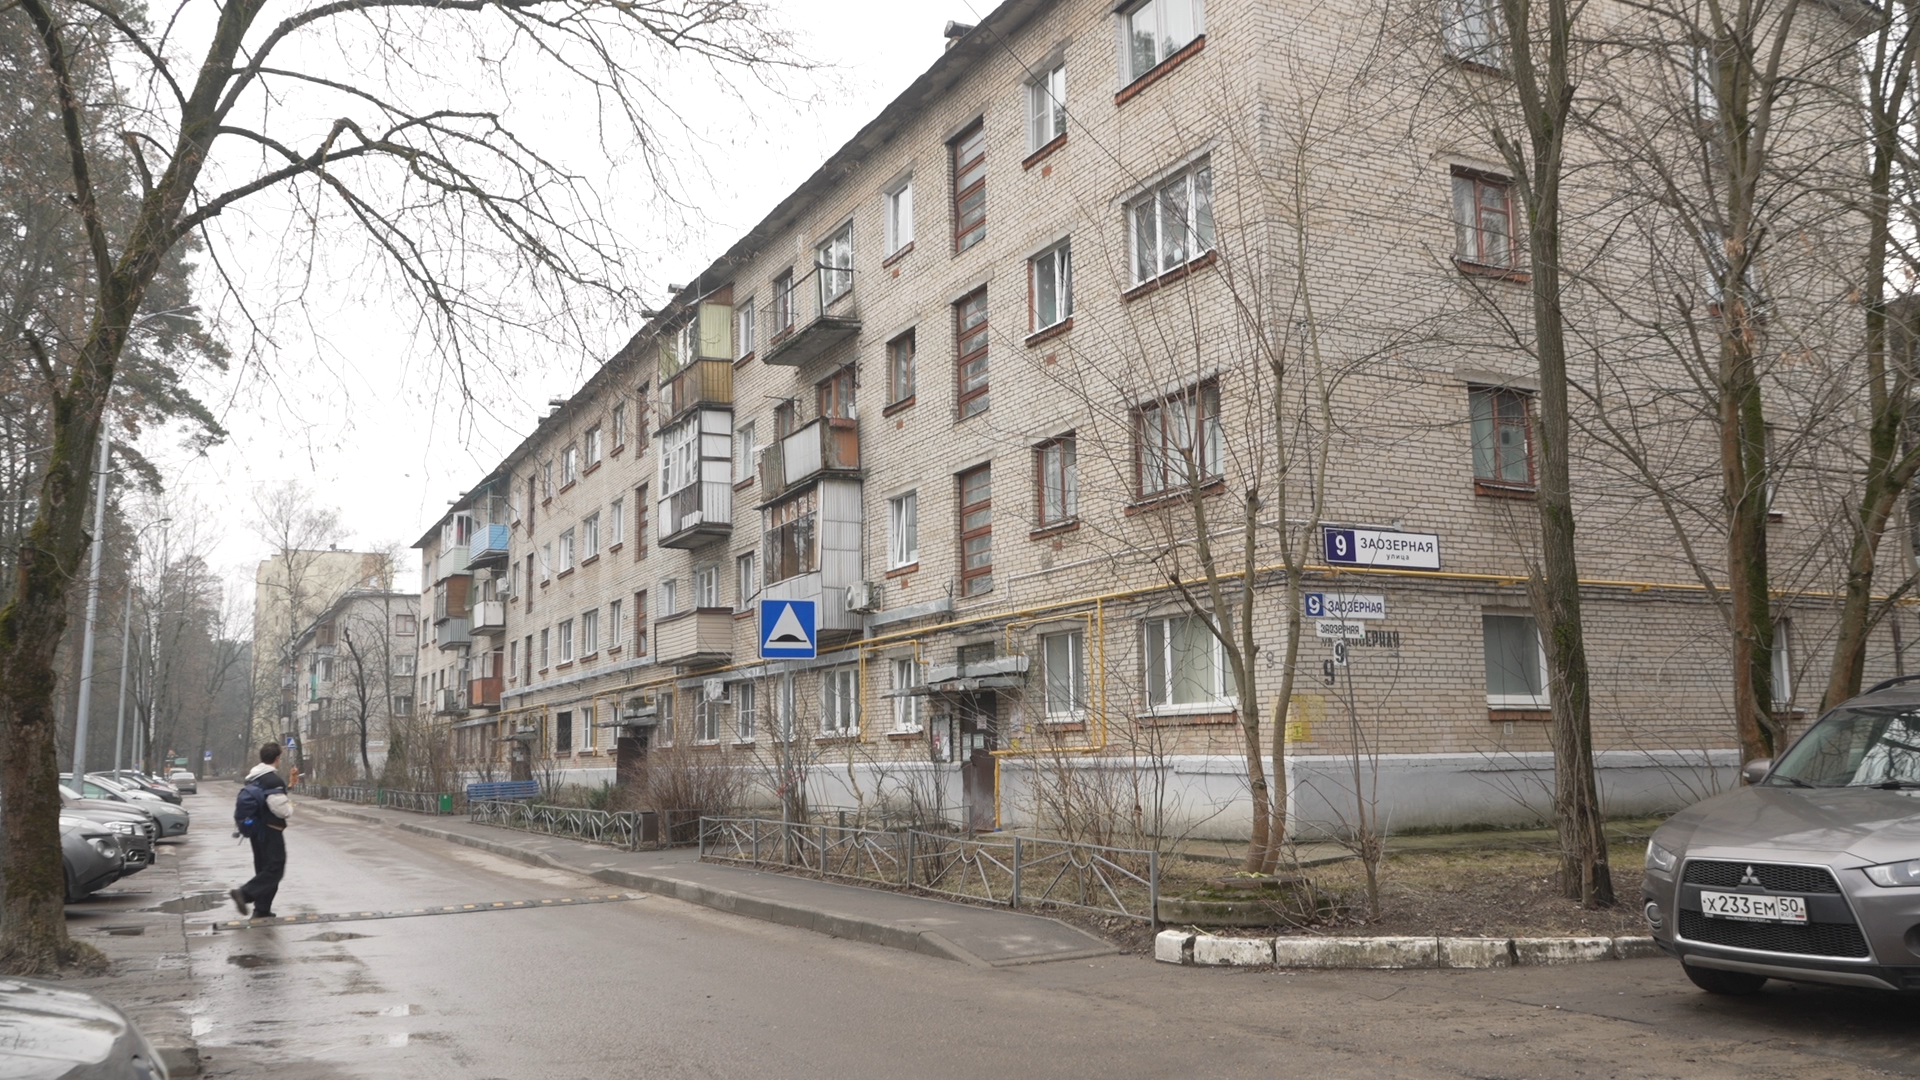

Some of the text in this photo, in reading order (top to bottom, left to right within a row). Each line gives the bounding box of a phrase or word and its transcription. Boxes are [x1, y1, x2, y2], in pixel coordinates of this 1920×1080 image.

[1335, 535, 1434, 556] 9 ЗАОЗЕРНАЯ
[1386, 553, 1410, 561] улица
[1308, 595, 1321, 614] 9
[1266, 651, 1274, 669] 9
[1335, 642, 1345, 663] 9
[1323, 659, 1335, 685] 9
[1780, 898, 1799, 912] 50
